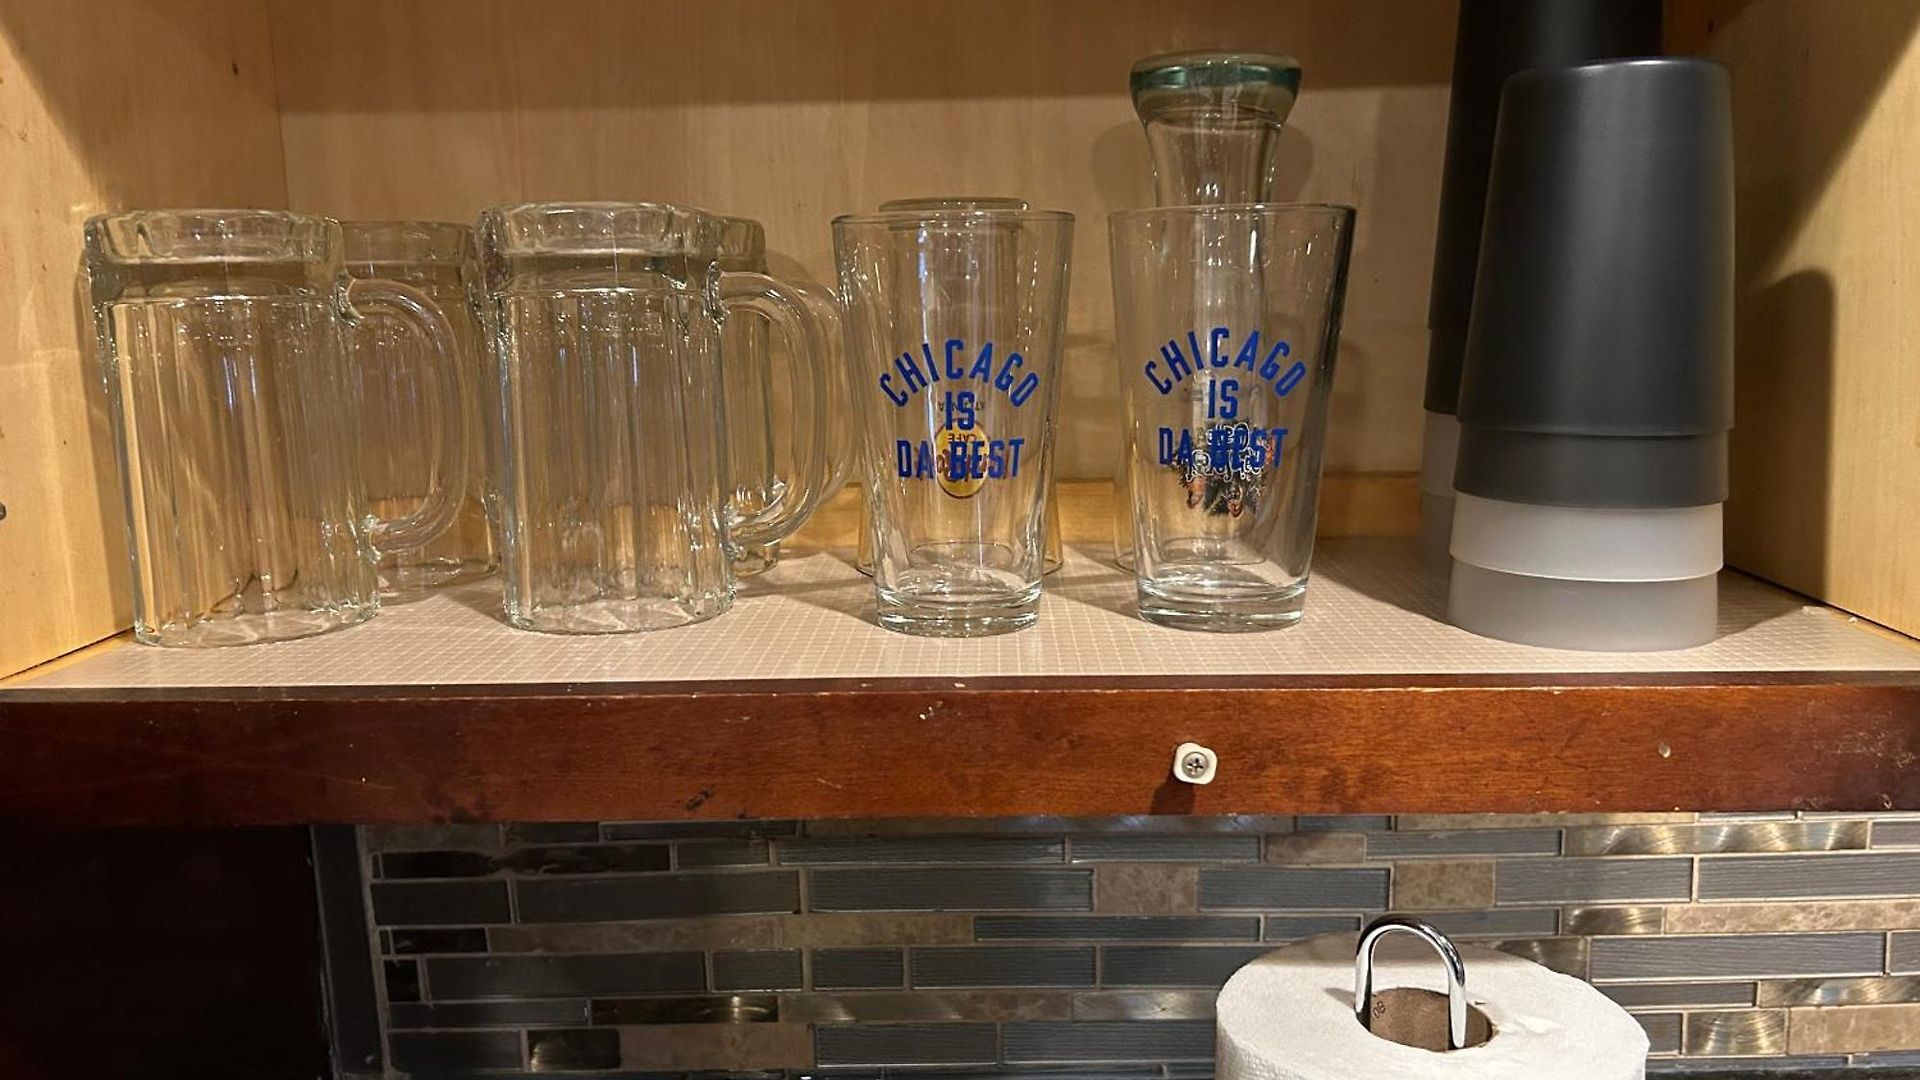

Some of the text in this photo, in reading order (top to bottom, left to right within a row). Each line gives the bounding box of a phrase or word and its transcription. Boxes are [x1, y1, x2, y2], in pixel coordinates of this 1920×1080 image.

[879, 339, 1039, 407] CHICAGO
[1144, 327, 1306, 397] CHICAGO
[945, 391, 975, 430] IS
[1207, 379, 1239, 419] IS
[896, 440, 934, 480] DA
[949, 438, 1025, 480] BEST
[1158, 427, 1194, 469] DA
[1209, 427, 1289, 470] BEST
